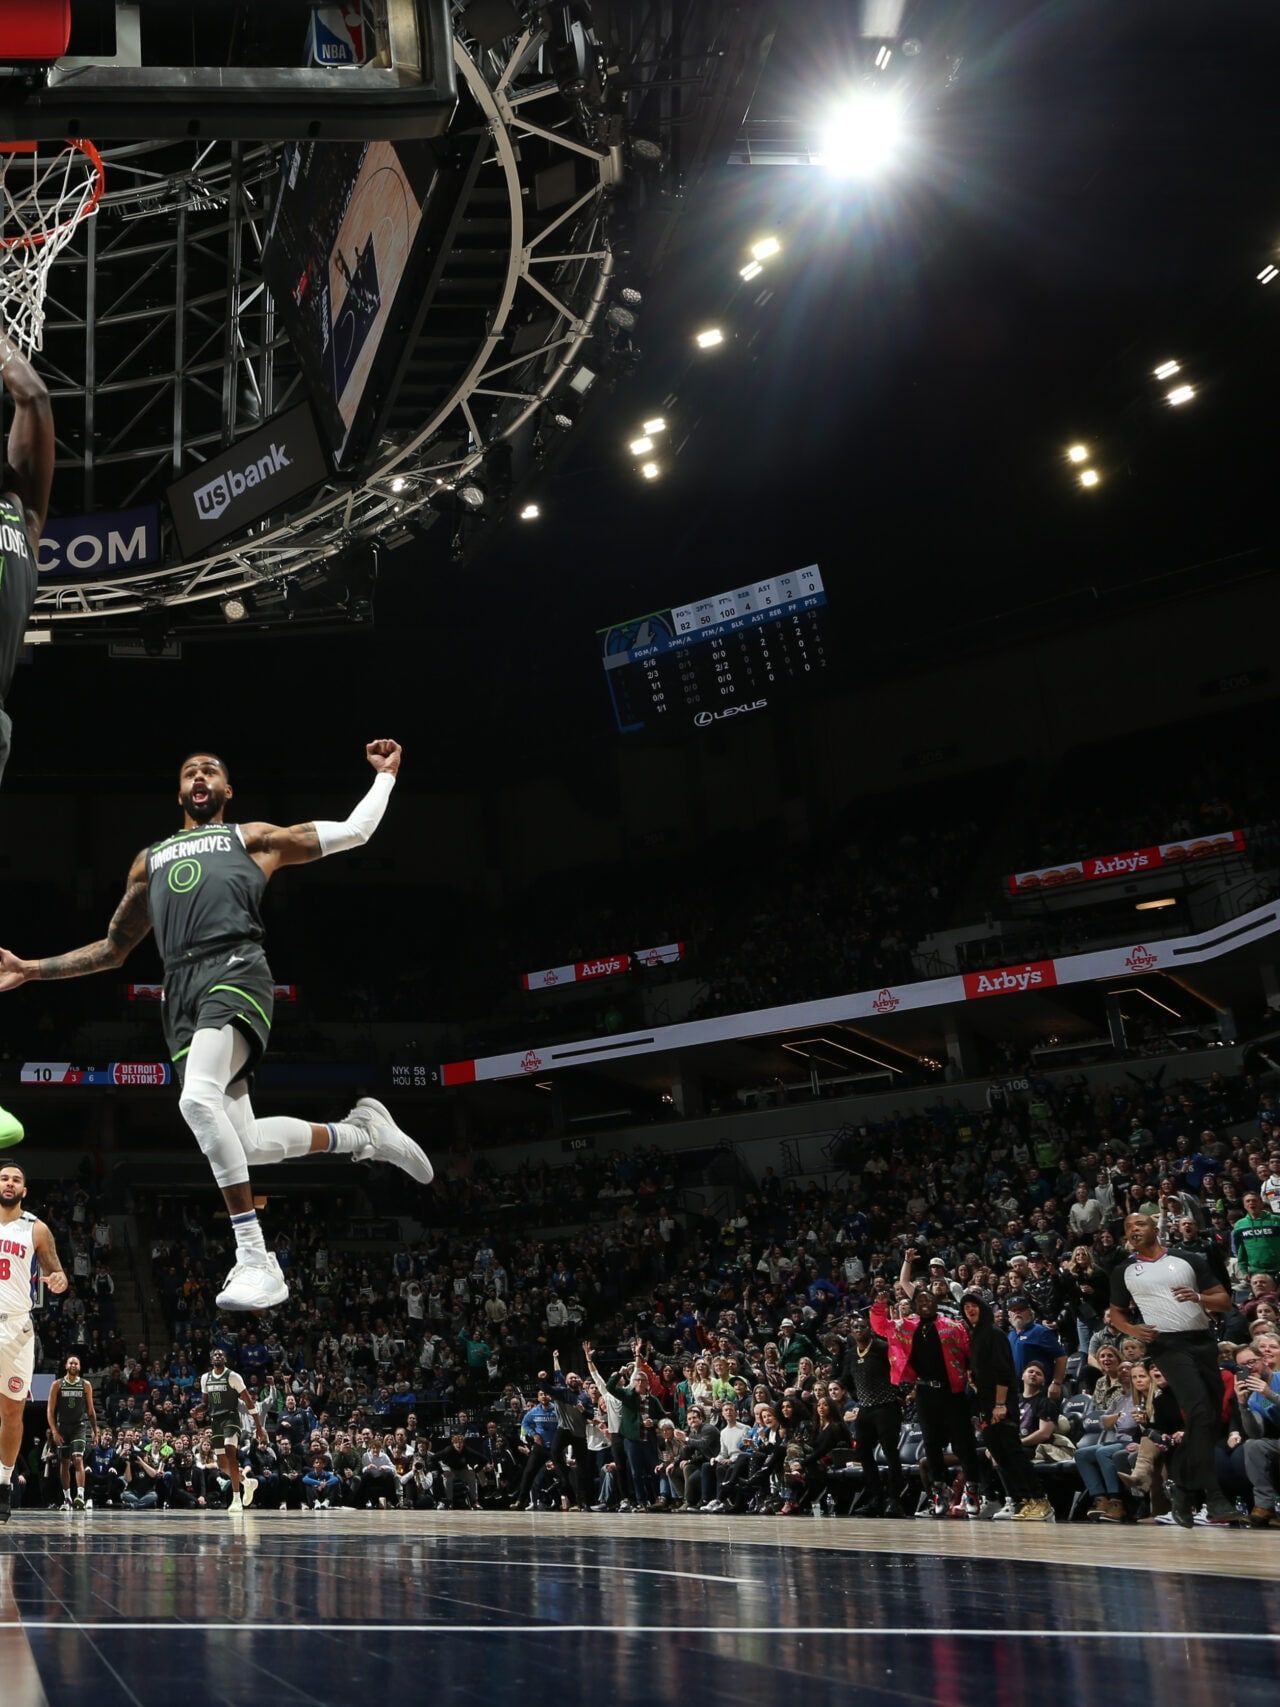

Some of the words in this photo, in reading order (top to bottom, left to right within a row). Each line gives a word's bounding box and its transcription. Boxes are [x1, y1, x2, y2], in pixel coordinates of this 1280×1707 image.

[322, 44, 346, 59] NBA
[714, 699, 768, 720] LEXUS
[150, 836, 231, 873] TIMBERWOLVES
[1093, 853, 1147, 874] Arby's
[168, 858, 201, 893] 0
[583, 958, 620, 976] Arby's
[977, 967, 1042, 993] Arby's
[34, 1068, 51, 1081] 10
[122, 1064, 156, 1074] DETROIT
[393, 1066, 410, 1075] NYK
[414, 1067, 425, 1075] 58
[121, 1074, 157, 1084] PISTONS
[393, 1077, 410, 1085] HOU
[414, 1077, 426, 1085] 53
[431, 1072, 438, 1081] 3
[1007, 1080, 1029, 1091] 106
[571, 1139, 586, 1150] 104
